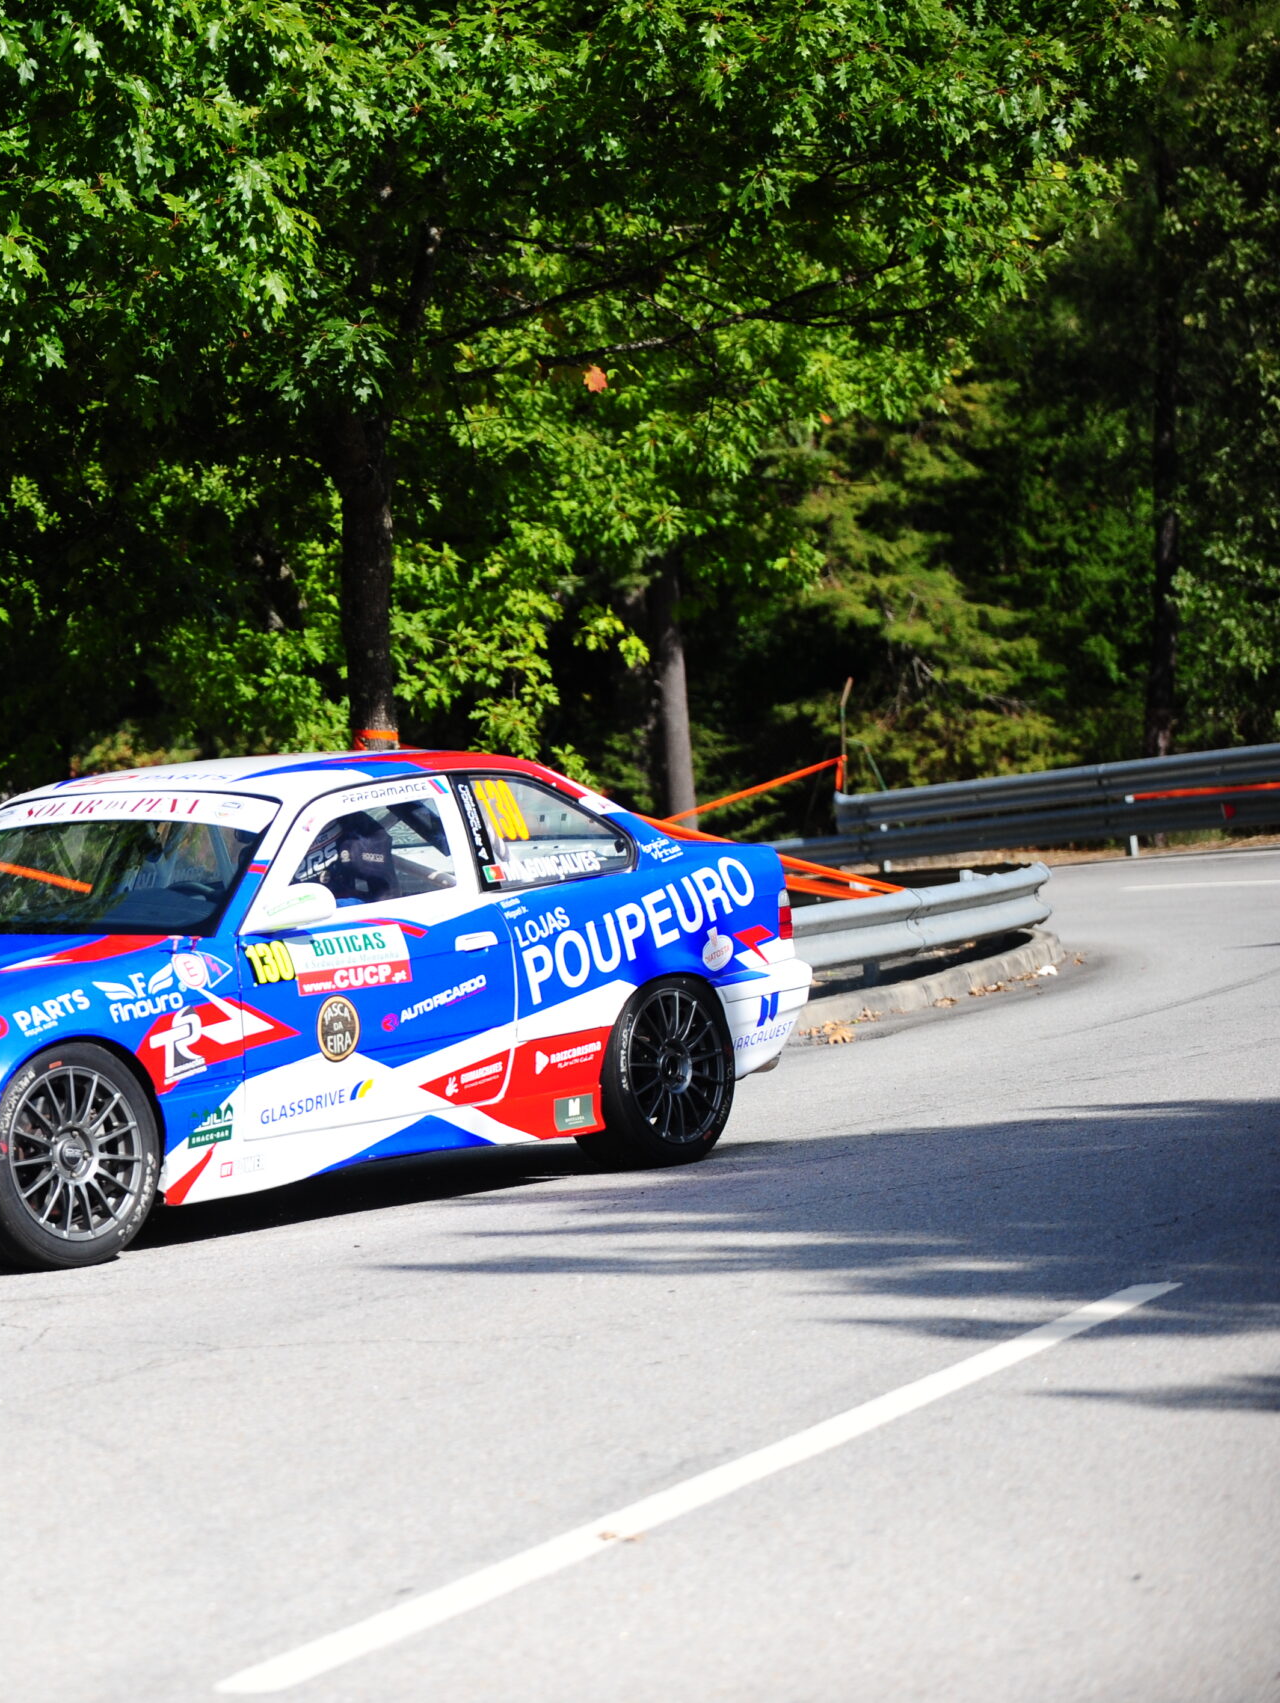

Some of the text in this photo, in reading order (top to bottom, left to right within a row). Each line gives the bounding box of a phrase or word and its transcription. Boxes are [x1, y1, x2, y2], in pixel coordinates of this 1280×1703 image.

[342, 782, 427, 803] PERFORMANCE
[474, 780, 529, 840] 130
[514, 906, 570, 948] LOJAS
[522, 857, 755, 1006] POUPEURO
[313, 932, 386, 957] BOTICAS
[245, 940, 295, 984] 130
[303, 964, 407, 993] www.CUCP.pt
[13, 989, 91, 1031] PARTS
[324, 1002, 352, 1026] TASCA
[333, 1021, 344, 1031] DA
[326, 1032, 352, 1053] EIRA
[260, 1088, 345, 1125] GLASSDRIVE
